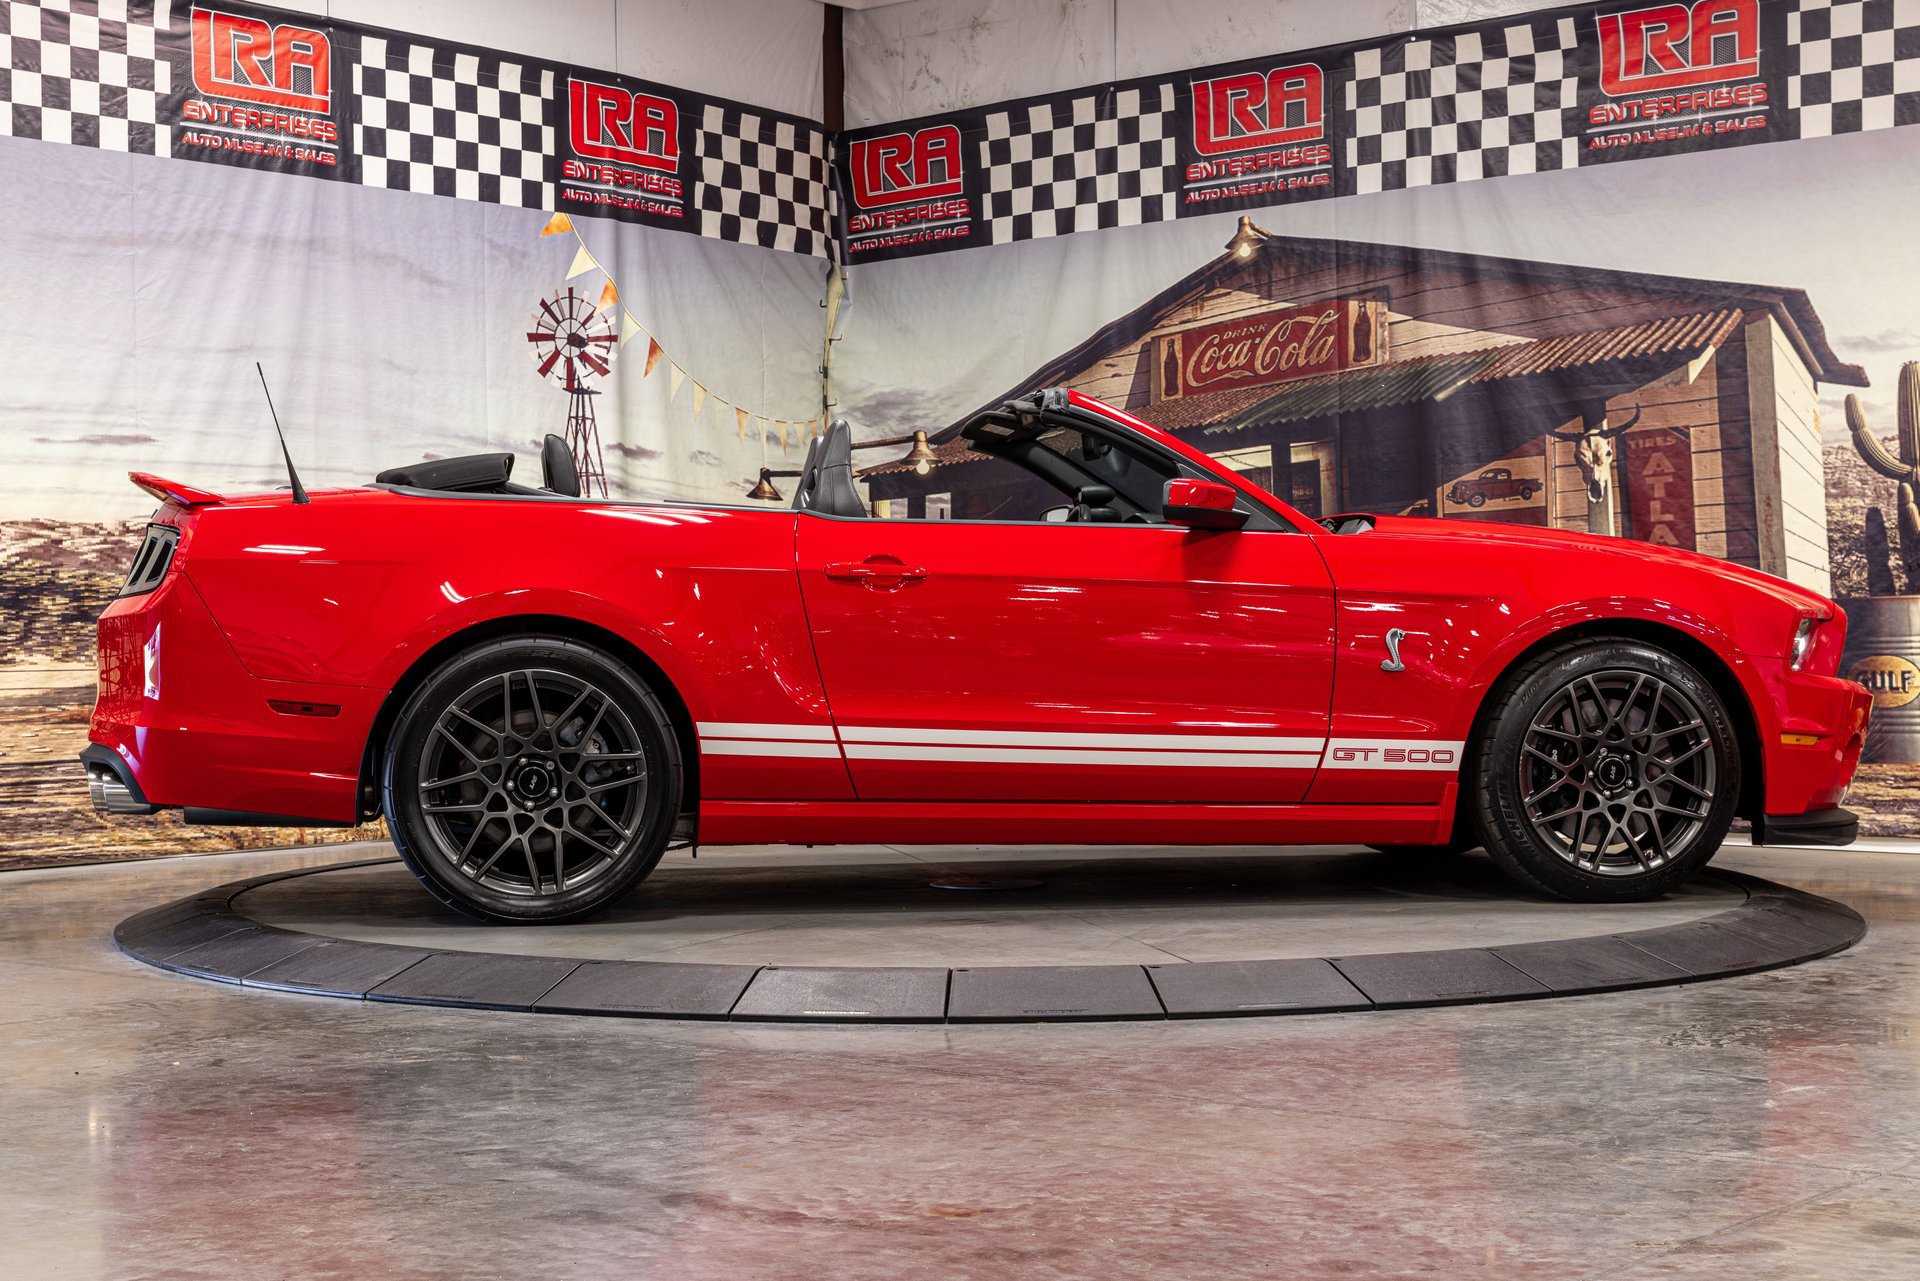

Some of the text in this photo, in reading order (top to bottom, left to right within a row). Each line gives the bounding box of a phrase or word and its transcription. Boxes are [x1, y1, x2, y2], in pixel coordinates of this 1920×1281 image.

[183, 99, 337, 141] ENTERPRISES
[1590, 83, 1768, 124] ENTERPRISES
[182, 132, 337, 165] AUTO MUSEUM & SALES
[1588, 115, 1766, 149] AUTO MUSEUM & SALES
[563, 160, 683, 197] ENTERPRISES
[1186, 144, 1330, 181] ENTERPRISES
[1185, 173, 1329, 203] AUTO MUSEUM & SALES
[850, 199, 970, 232] ENTERPRISES
[1223, 323, 1268, 340] DRINK
[1186, 309, 1343, 388] Coca-Cola
[1628, 436, 1676, 449] TIRES
[1857, 670, 1916, 693] GULF
[1333, 748, 1454, 763] GT 500
